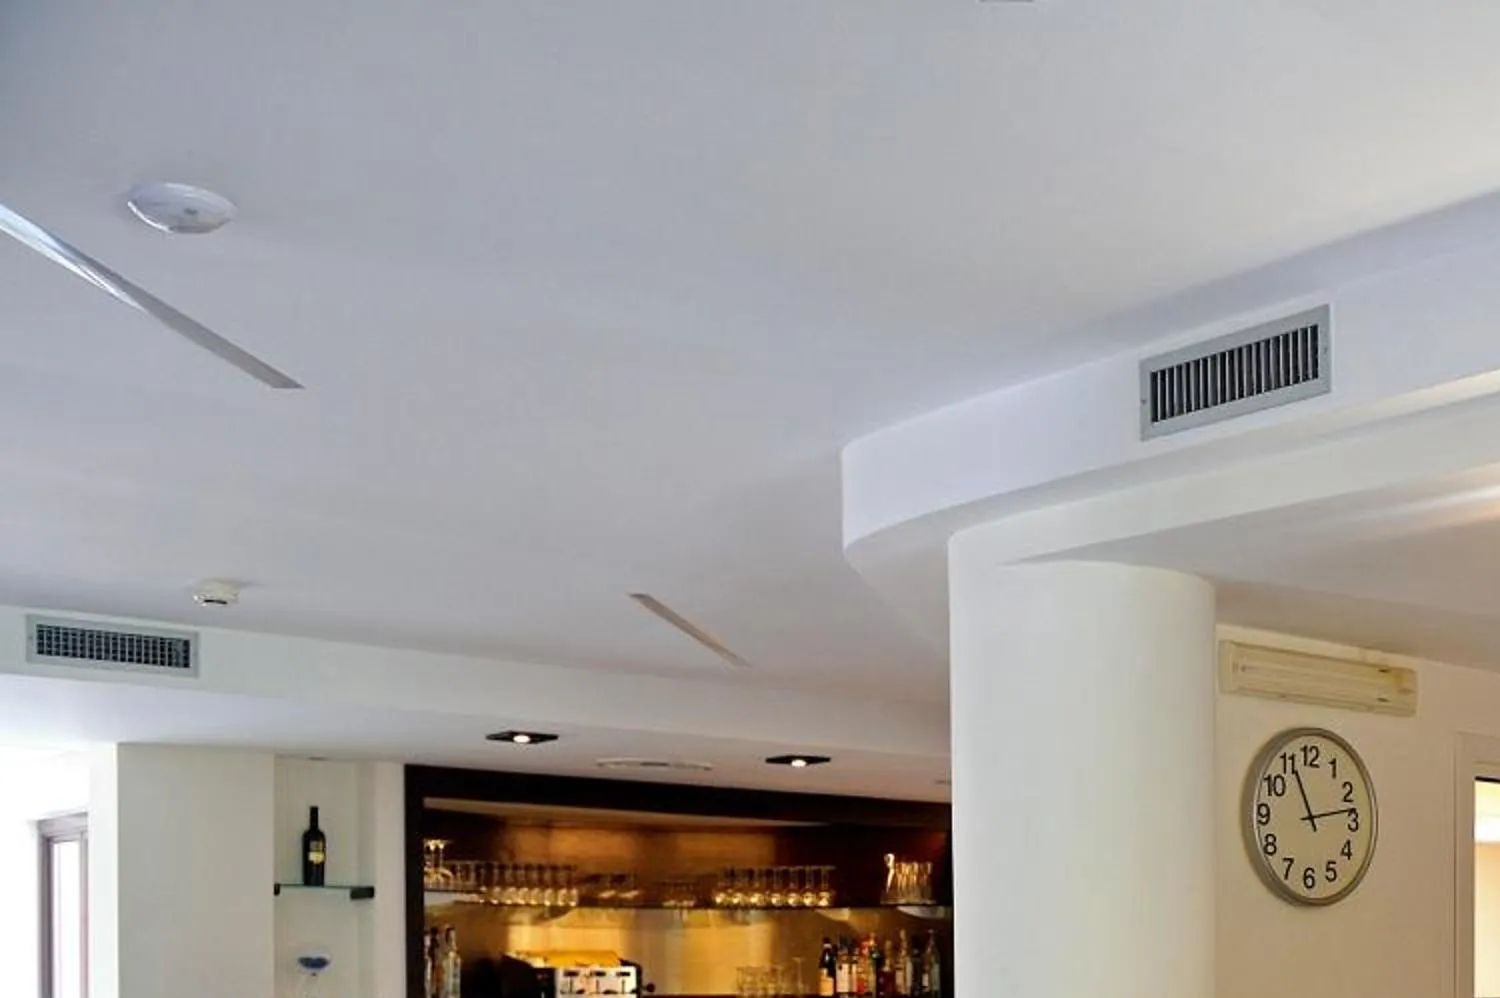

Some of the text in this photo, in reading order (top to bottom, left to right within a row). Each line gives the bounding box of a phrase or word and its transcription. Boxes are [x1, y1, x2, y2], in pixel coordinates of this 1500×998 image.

[1280, 752, 1296, 775] 11
[1300, 745, 1320, 768] 12
[1328, 758, 1337, 779] 1
[1264, 774, 1286, 797] 10
[1342, 781, 1354, 803] 2
[1257, 803, 1271, 826] 9
[1347, 808, 1360, 832] 3
[1264, 833, 1277, 856] 8
[1340, 840, 1352, 860] 4
[1283, 858, 1295, 880] 7
[1303, 867, 1315, 889] 6
[1325, 861, 1338, 882] 5
